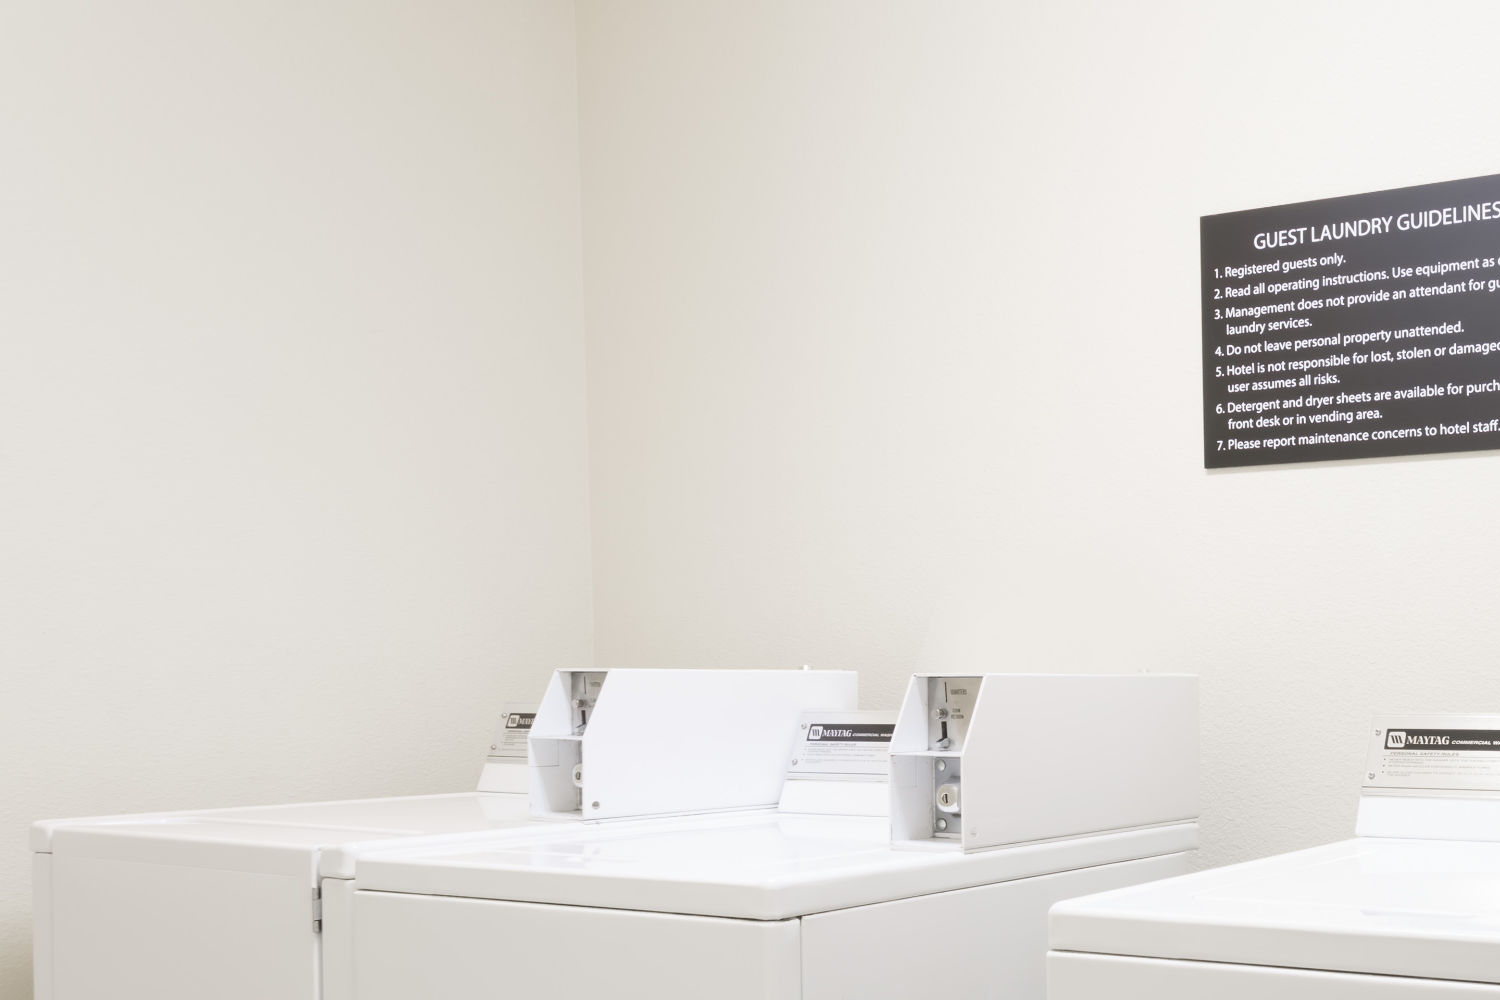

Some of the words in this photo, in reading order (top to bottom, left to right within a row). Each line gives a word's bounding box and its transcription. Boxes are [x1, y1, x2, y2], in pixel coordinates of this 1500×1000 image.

[1253, 227, 1308, 250] GUEST
[1310, 215, 1394, 243] LAUNDRY
[1213, 288, 1224, 300] 2.
[1224, 283, 1251, 298] Read
[1252, 282, 1266, 295] all
[1267, 277, 1320, 295] operating
[1322, 270, 1390, 287] instructions.
[1391, 266, 1414, 279] Use
[1415, 257, 1480, 278] equipment
[1481, 257, 1496, 268] as
[1214, 268, 1223, 279] 1.
[1224, 259, 1280, 279] Registered
[1281, 256, 1318, 274] guests
[1319, 252, 1347, 267] only.
[1213, 308, 1224, 320] 3.
[1225, 300, 1296, 319] Management
[1296, 298, 1324, 311] does
[1325, 295, 1345, 308] not
[1346, 289, 1391, 308] provide
[1392, 289, 1407, 301] an
[1408, 281, 1467, 299] attendant
[1467, 278, 1486, 292] for
[1214, 345, 1225, 357] 4.
[1226, 344, 1242, 356] Do
[1243, 342, 1263, 354] not
[1263, 340, 1293, 352] leave
[1294, 332, 1341, 352] personal
[1343, 329, 1392, 347] property
[1393, 320, 1465, 340] unattended.
[1226, 320, 1267, 336] laundry
[1267, 317, 1313, 332] services.
[1215, 366, 1225, 378] 5.
[1226, 362, 1255, 377] Hotel
[1257, 362, 1266, 374] is
[1267, 360, 1286, 373] not
[1288, 353, 1351, 372] responsible
[1352, 352, 1369, 365] for
[1370, 350, 1394, 363] lost,
[1396, 346, 1432, 361] stolen
[1433, 346, 1447, 357] or
[1227, 382, 1250, 393] user
[1251, 378, 1297, 391] assumes
[1298, 373, 1312, 387] all
[1313, 372, 1341, 385] risks.
[1215, 403, 1226, 415] 6.
[1227, 399, 1281, 414] Detergent
[1282, 395, 1303, 409] and
[1304, 394, 1335, 409] dryer
[1336, 391, 1372, 405] sheets
[1373, 391, 1392, 402] are
[1393, 383, 1445, 400] available
[1446, 382, 1464, 395] for
[1227, 418, 1254, 430] front
[1255, 414, 1281, 428] desk
[1282, 416, 1295, 426] or
[1296, 413, 1307, 425] in
[1308, 410, 1354, 424] vending
[1355, 409, 1383, 421] area.
[1216, 440, 1226, 451] 7.
[1227, 438, 1261, 451] Please
[1262, 435, 1297, 450] report
[1298, 431, 1370, 446] maintenance
[1371, 427, 1423, 441] concerns
[1424, 425, 1438, 437] to
[1439, 421, 1470, 436] hotel
[822, 729, 853, 738] MAYTAG
[1406, 735, 1450, 745] MAYTAG
